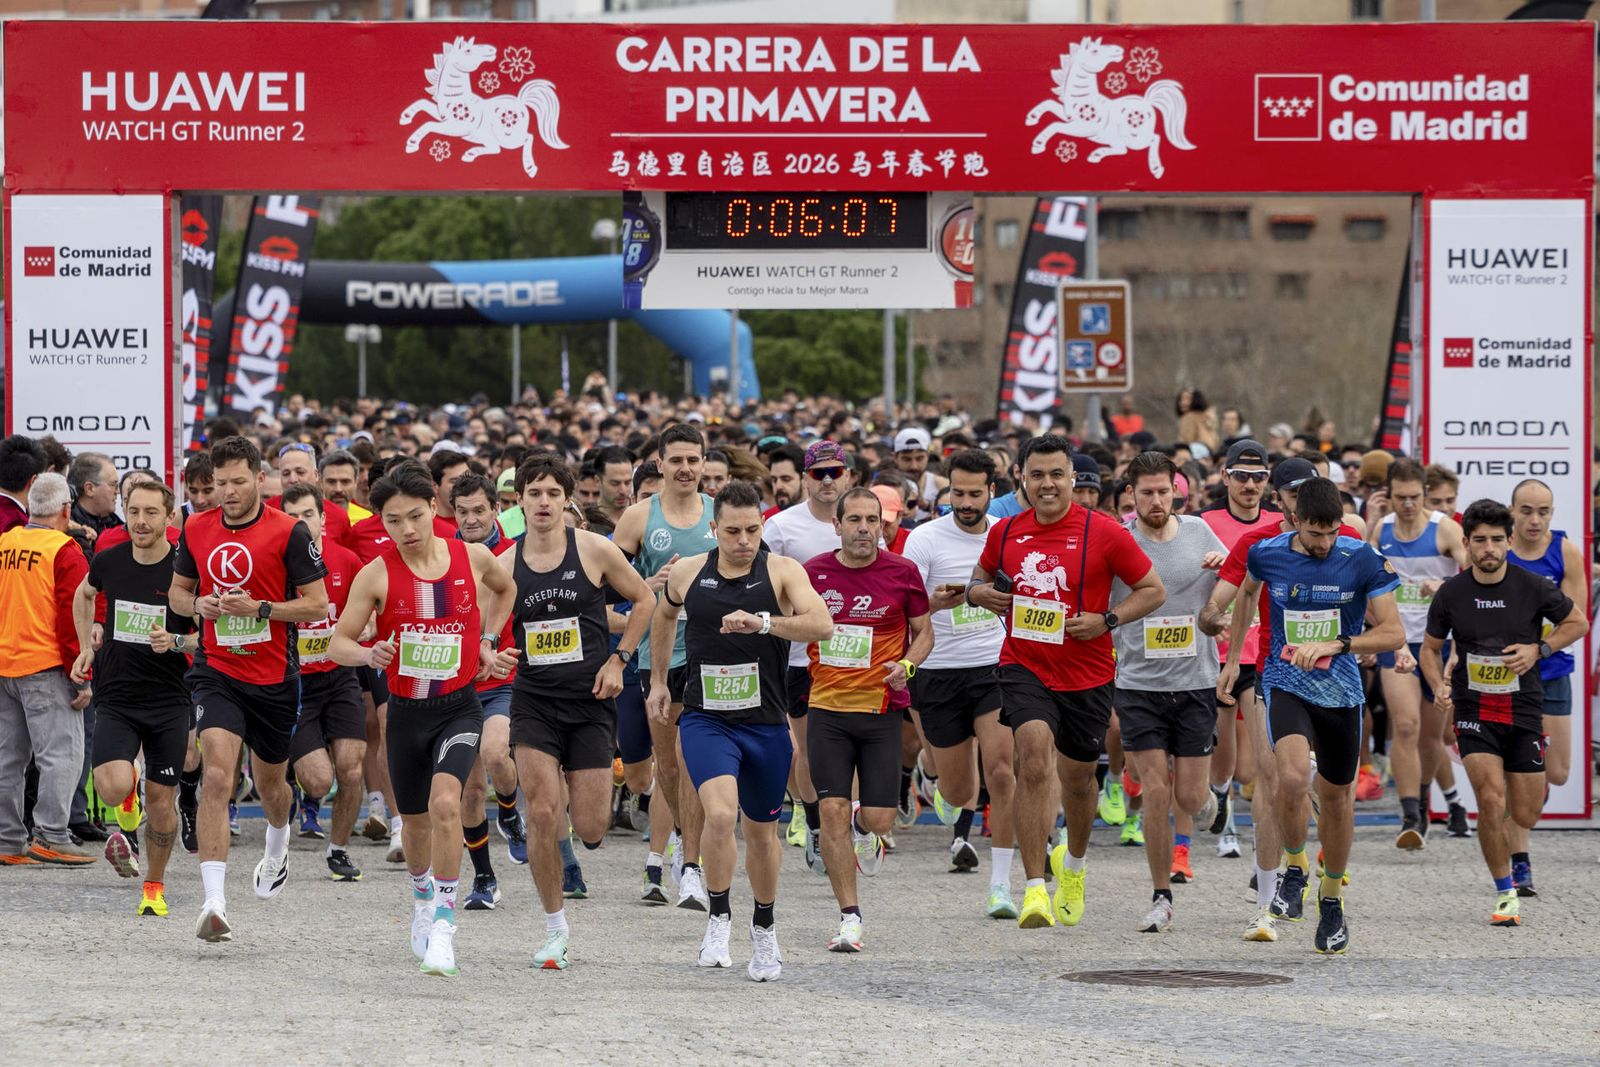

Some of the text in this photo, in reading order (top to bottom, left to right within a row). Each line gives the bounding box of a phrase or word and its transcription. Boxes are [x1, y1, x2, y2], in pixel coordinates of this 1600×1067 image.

[616, 36, 982, 72] CARRERA DE LA
[82, 71, 305, 112] HUAWEI
[1329, 74, 1529, 102] Comunidad
[666, 86, 931, 122] PRIMAVERA
[83, 121, 305, 141] WATCH GT Runner 2
[1329, 111, 1528, 141] de Madrid
[608, 149, 989, 179] 马德里自治区 2026 马年春节跑
[727, 199, 897, 237] 0:06:07
[59, 246, 152, 259] Comunidad
[247, 252, 279, 272] KISS
[1448, 248, 1568, 269] HUAWEI
[59, 263, 152, 277] de Madrid
[697, 266, 898, 278] HUAWEI WATCH GT Runner 2
[1448, 274, 1568, 285] WATCH GT Runner 2
[346, 281, 558, 309] POWERADE
[728, 286, 869, 296] Contigo Hacia tu Mejor Marca
[29, 328, 148, 349] HUAWEI
[1478, 338, 1572, 350] Comunidad
[231, 283, 292, 414] KISS
[29, 354, 148, 365] WATCH GT Runner 2
[1478, 355, 1571, 368] de Madrid
[26, 416, 151, 431] OMODA
[1444, 421, 1570, 436] OMODA
[524, 588, 578, 608] SPEEDFARM
[852, 595, 873, 611] 29
[1024, 608, 1056, 627] 3188
[1155, 627, 1188, 643] 4250
[1296, 621, 1331, 638] 5870
[536, 631, 571, 650] 3486
[829, 635, 863, 653] 6921
[412, 645, 452, 664] 6060
[1478, 665, 1509, 681] 4287
[714, 677, 749, 694] 5254
